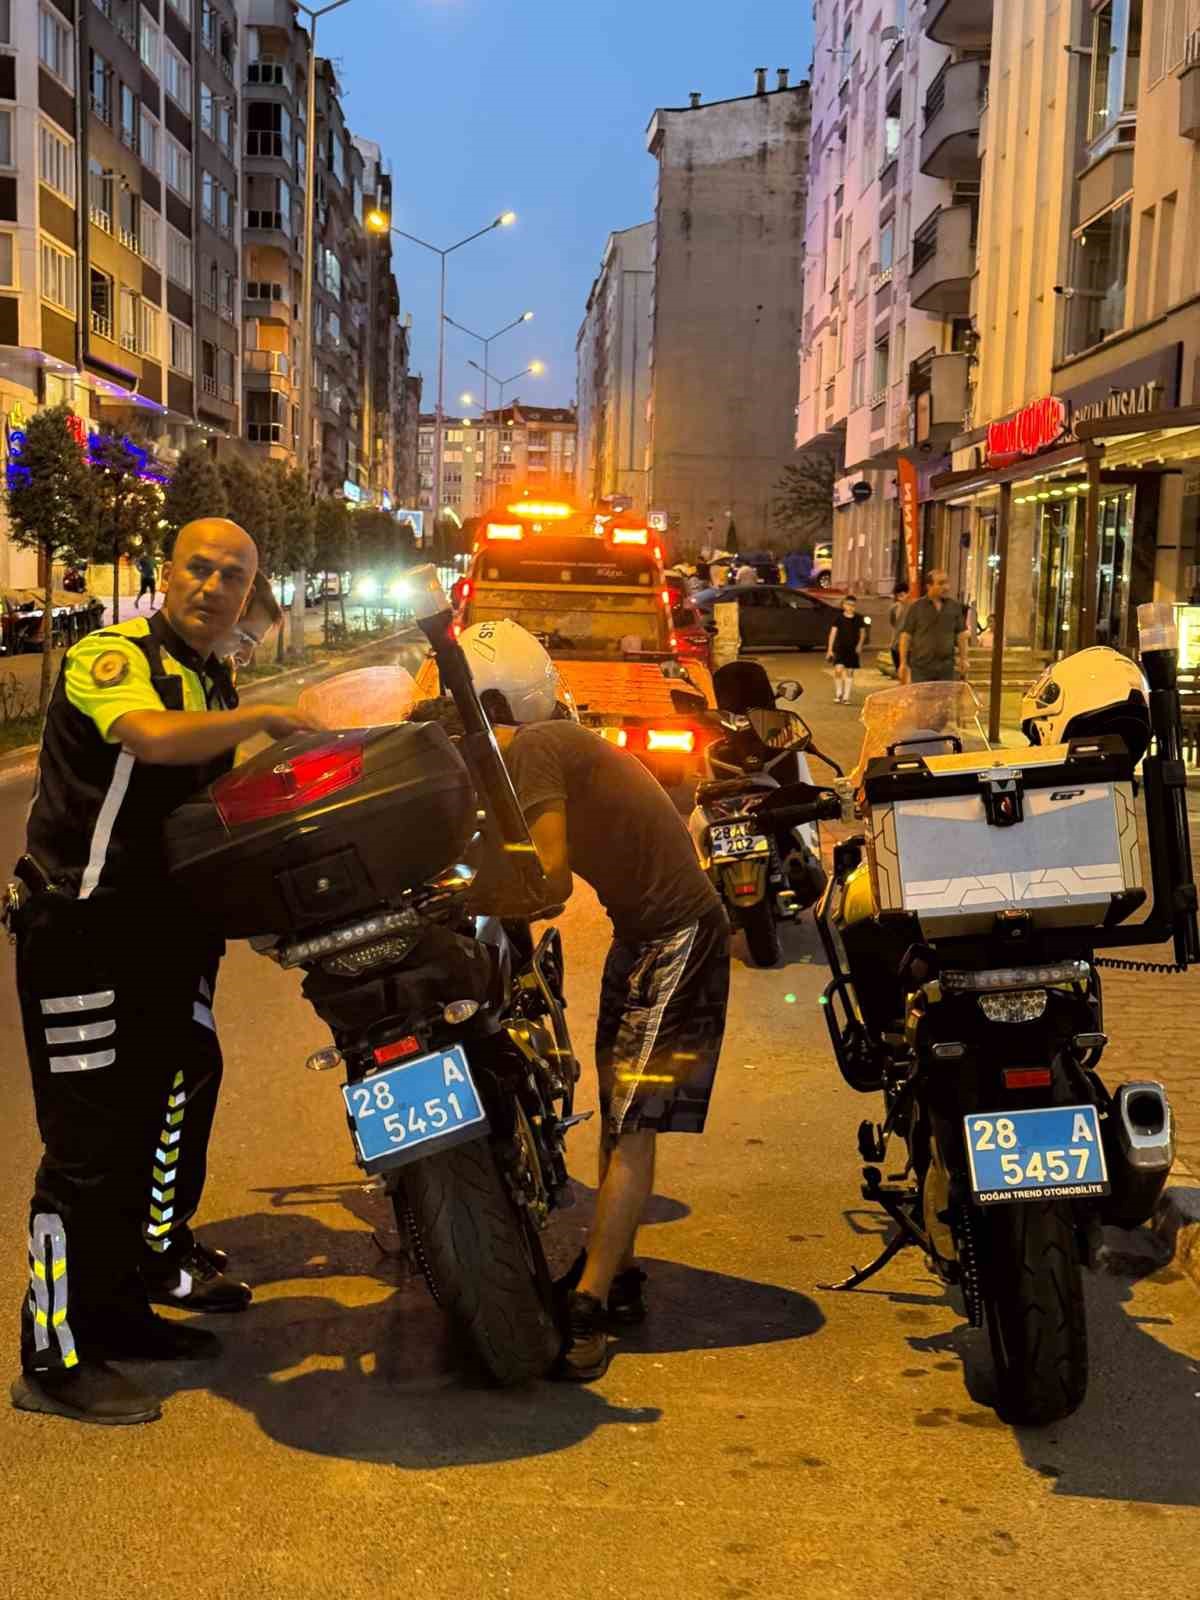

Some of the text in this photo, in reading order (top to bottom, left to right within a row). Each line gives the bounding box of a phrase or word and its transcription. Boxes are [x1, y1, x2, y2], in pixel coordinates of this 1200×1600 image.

[727, 837, 754, 853] 202
[352, 1056, 465, 1119] 28 A
[383, 1092, 464, 1143] 5451
[973, 1112, 1094, 1151] 28 A
[1000, 1148, 1091, 1186] 5457
[979, 1188, 1012, 1202] DOĞAN
[1013, 1188, 1043, 1200] TREND
